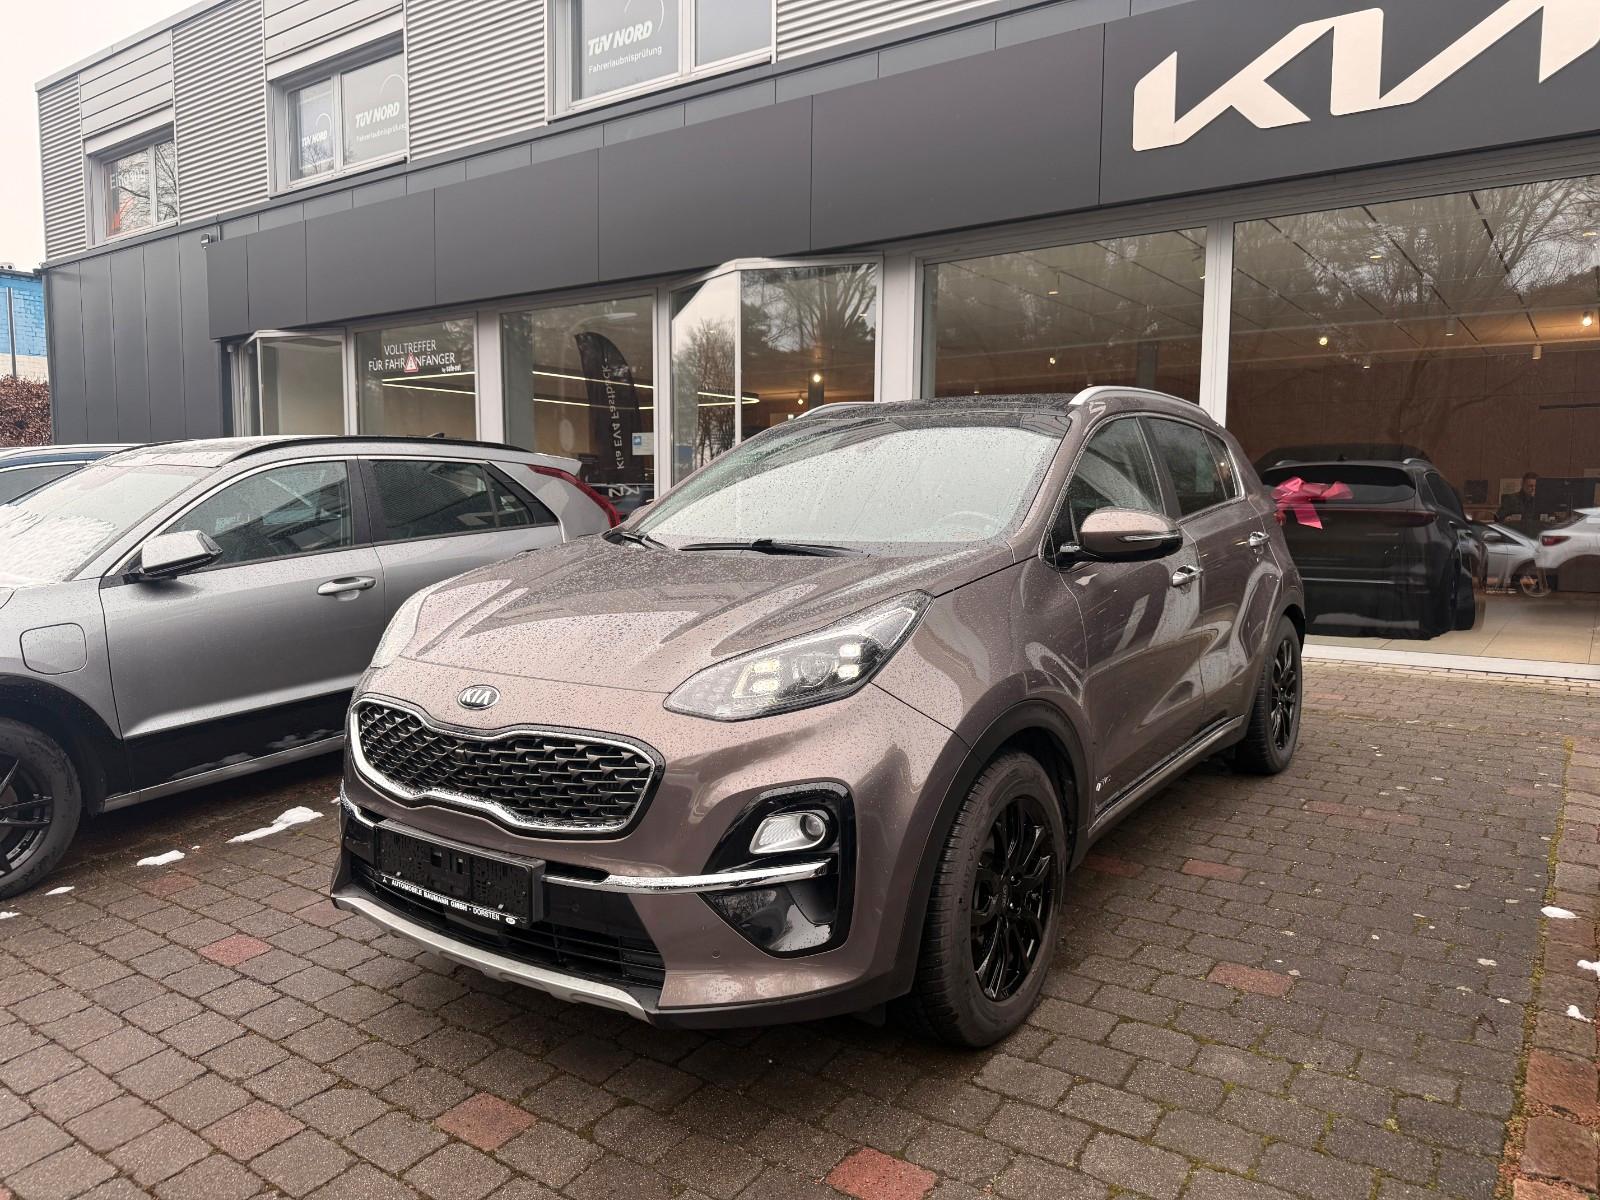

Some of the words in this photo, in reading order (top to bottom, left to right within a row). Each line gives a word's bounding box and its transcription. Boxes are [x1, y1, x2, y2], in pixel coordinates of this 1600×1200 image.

[588, 32, 613, 56] TÜV
[613, 20, 653, 49] NORD
[588, 46, 663, 73] Fahrerlaubnisprüfung
[355, 110, 373, 129] TÜV
[372, 102, 400, 123] NORD
[384, 339, 437, 356] VOLLTREFFER
[368, 357, 384, 371] FÜR
[461, 688, 492, 705] KIA
[391, 879, 423, 896] AUTOMOBILE
[423, 889, 449, 906] BAUMANN
[472, 907, 500, 921] DORSTEN
